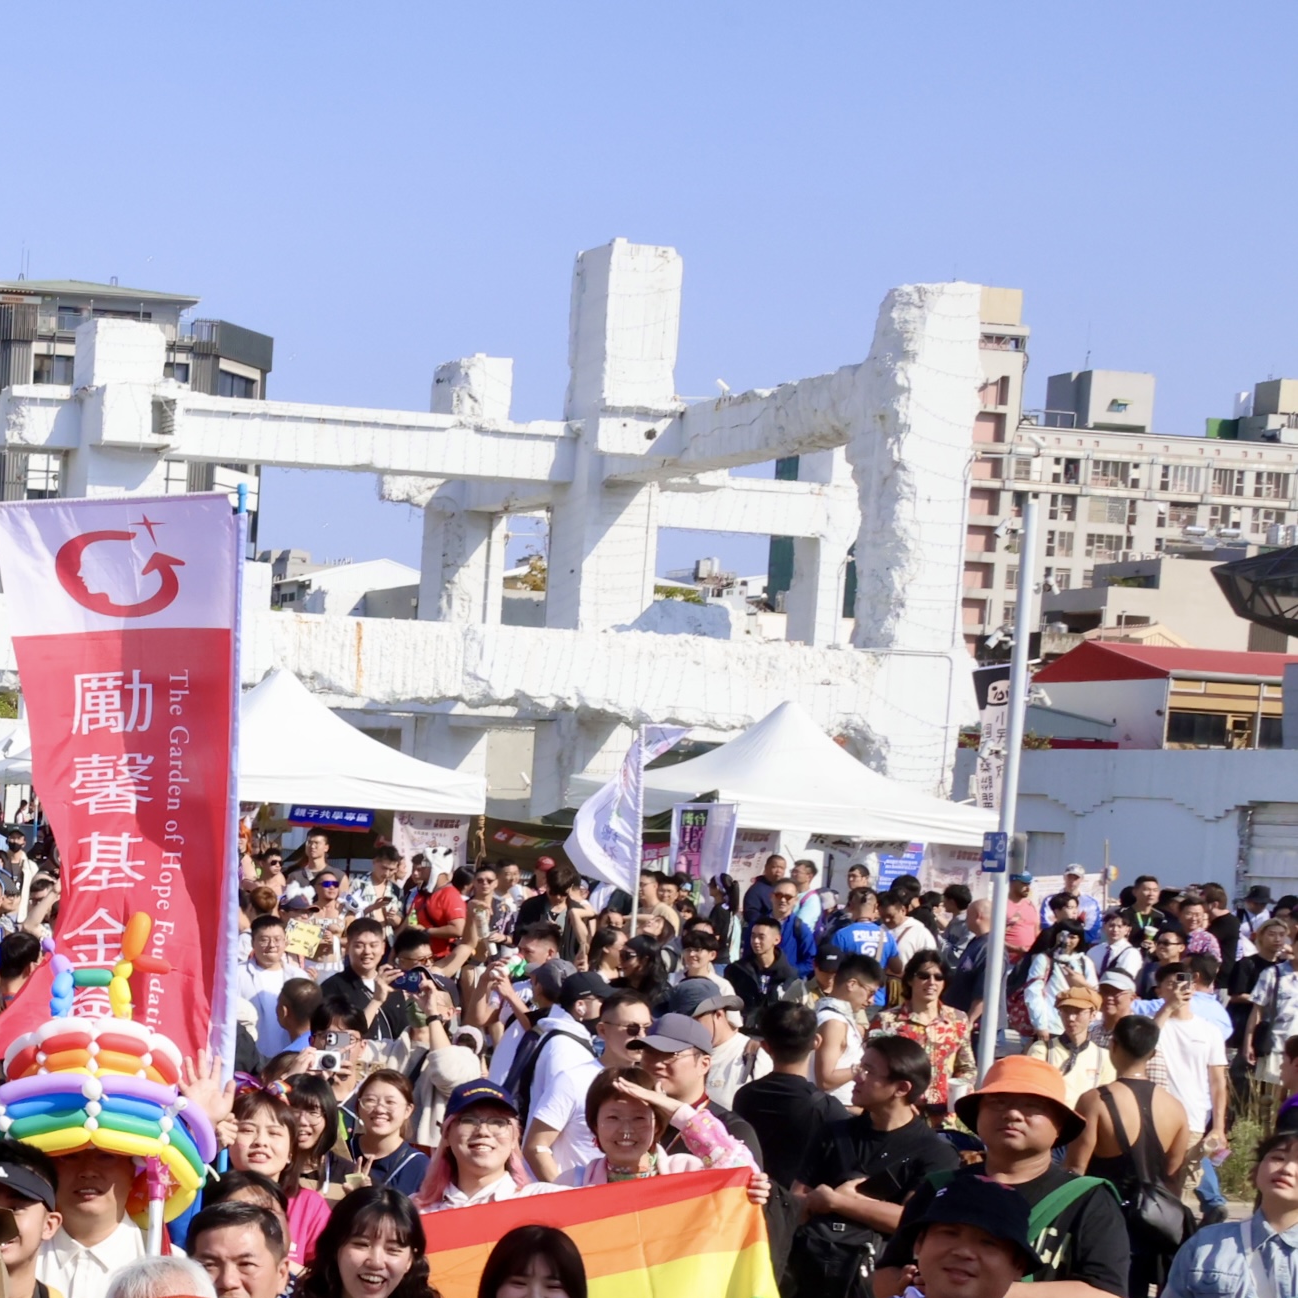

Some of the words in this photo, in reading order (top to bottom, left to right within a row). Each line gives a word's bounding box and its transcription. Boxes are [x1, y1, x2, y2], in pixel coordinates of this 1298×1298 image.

[168, 669, 189, 716] The
[166, 725, 190, 812] Garden
[164, 819, 186, 845] of
[293, 807, 370, 823] 親子共學專區
[151, 851, 182, 910] Hope
